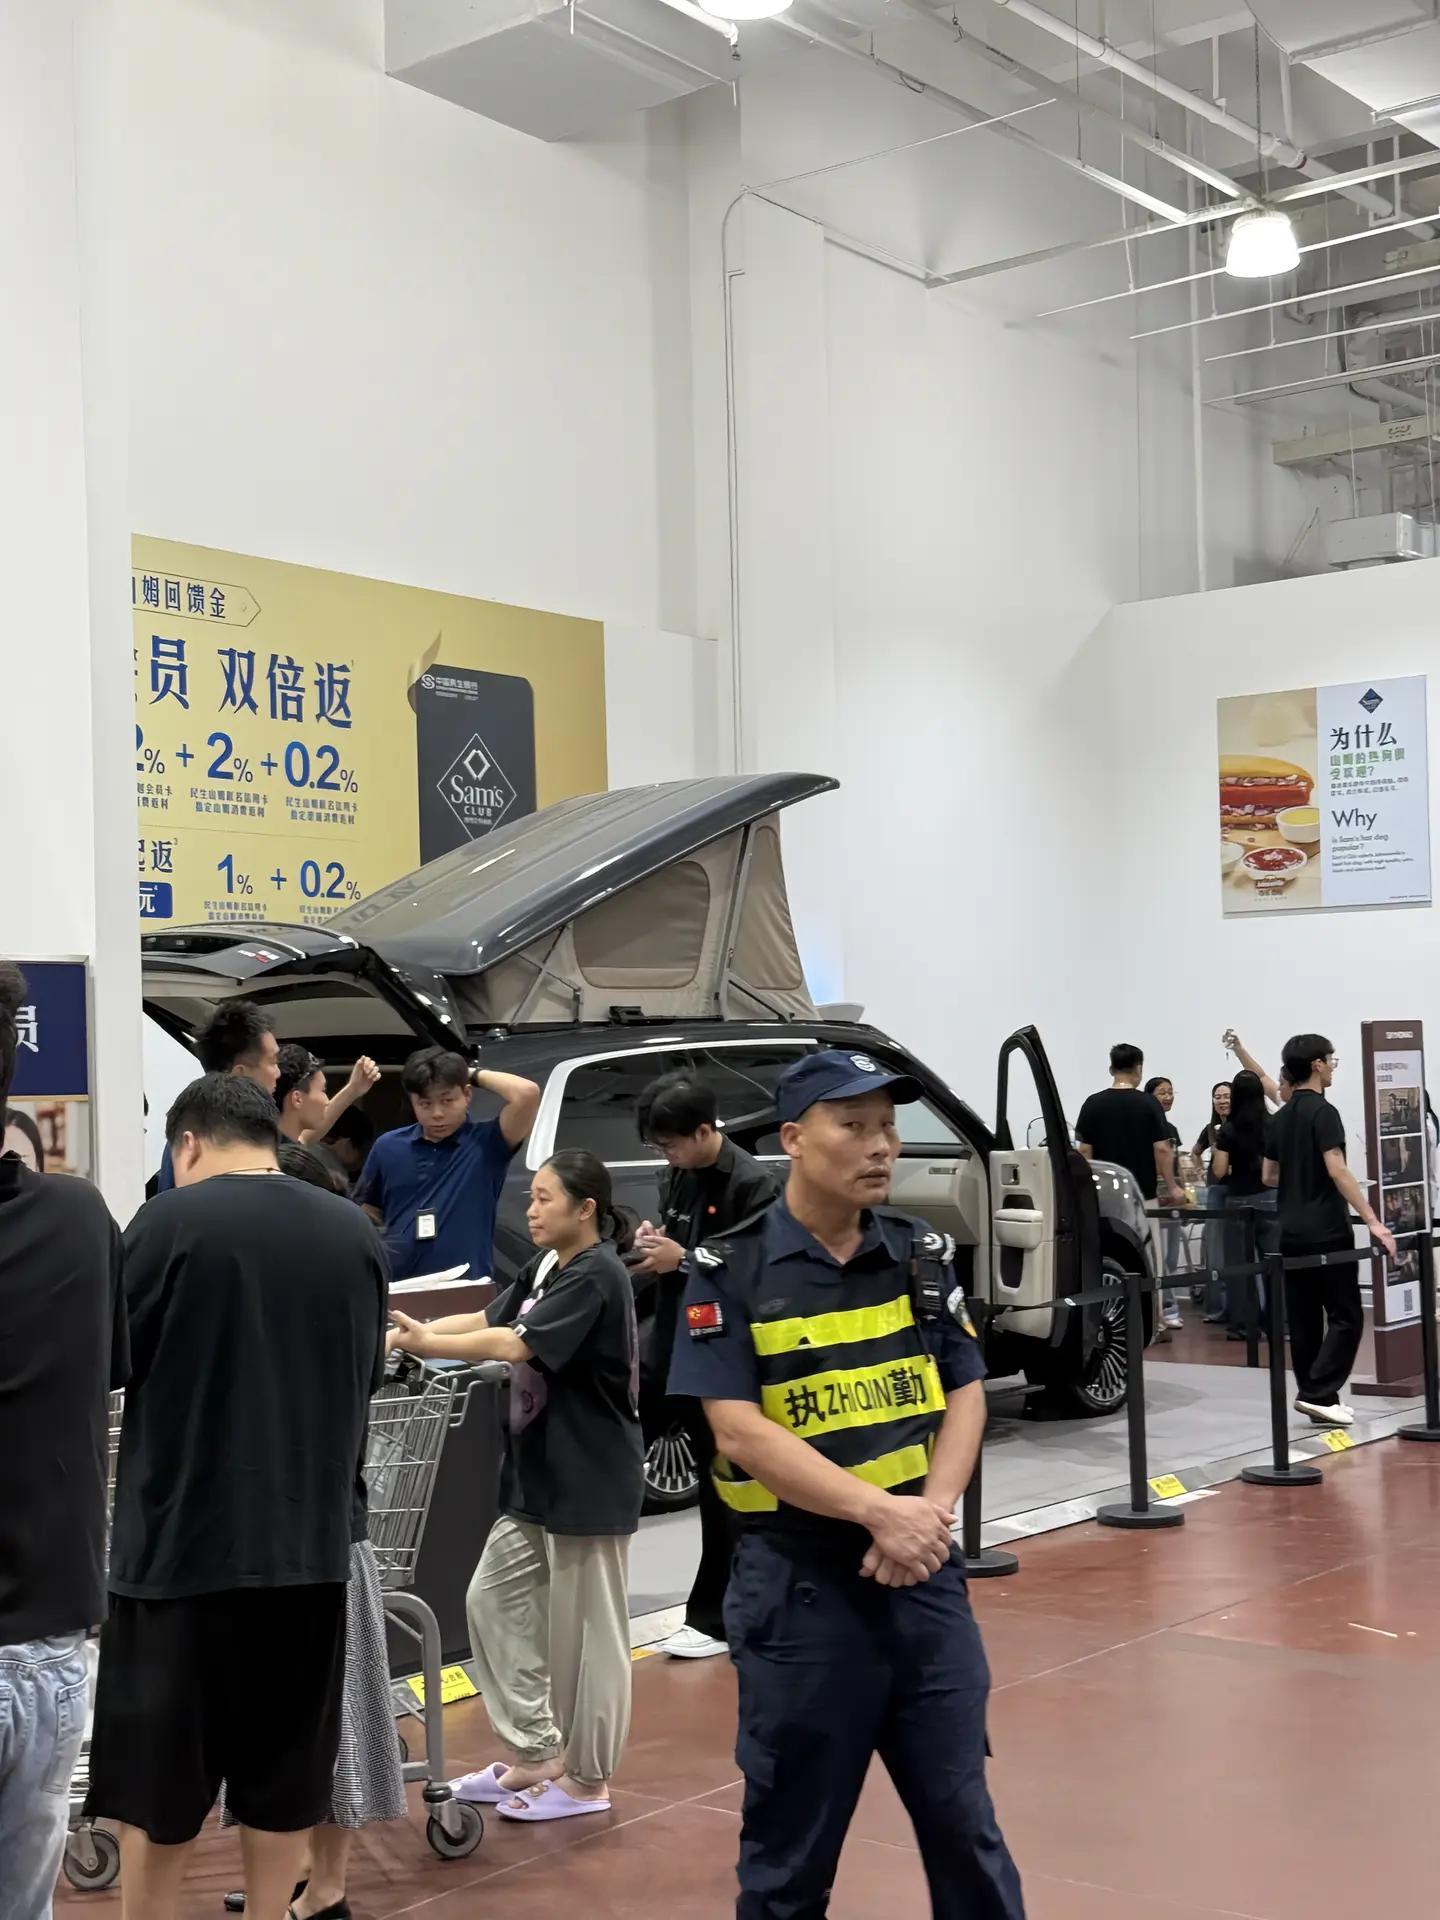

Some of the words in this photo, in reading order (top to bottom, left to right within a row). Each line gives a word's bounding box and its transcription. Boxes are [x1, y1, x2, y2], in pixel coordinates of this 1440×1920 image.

[133, 635, 190, 710] 员
[217, 648, 352, 729] 双倍返
[1330, 722, 1397, 752] 为什么
[207, 732, 253, 783] 2%
[284, 740, 358, 793] 0.2%
[451, 774, 504, 808] Sam's
[464, 805, 492, 817] CLUB
[1331, 808, 1378, 831] Why
[217, 854, 253, 895] 1%
[301, 860, 361, 900] 0.2%
